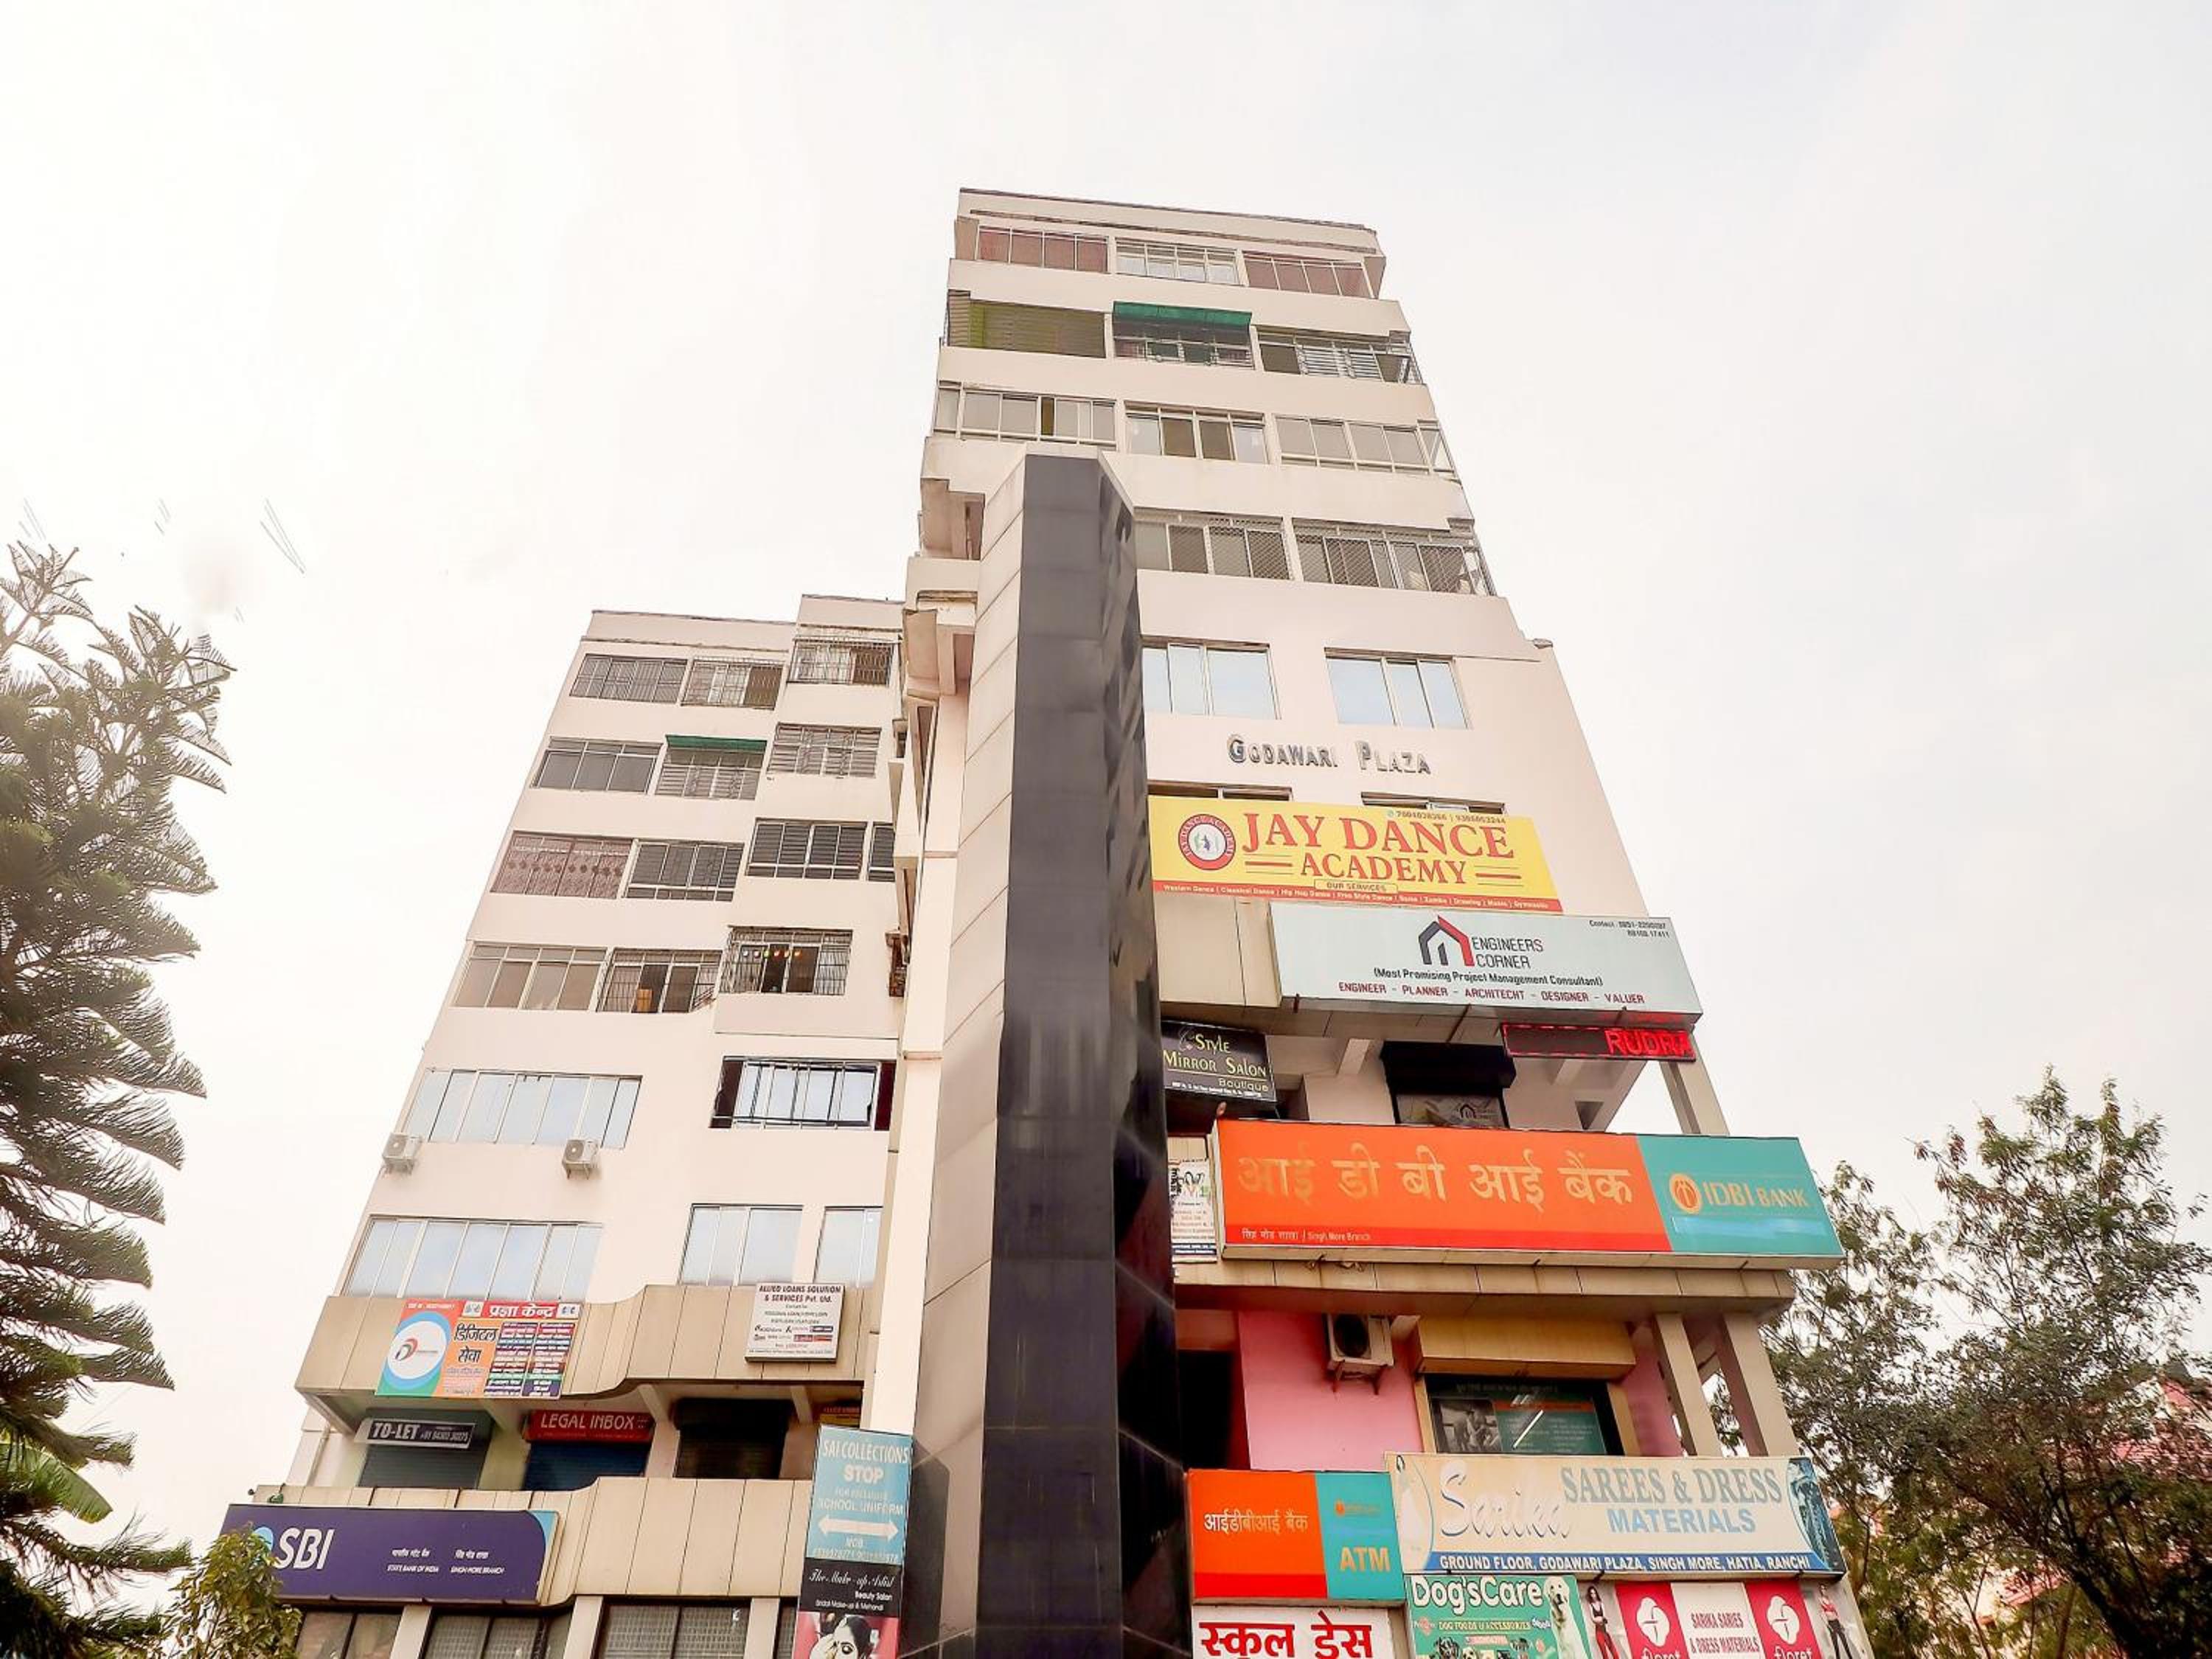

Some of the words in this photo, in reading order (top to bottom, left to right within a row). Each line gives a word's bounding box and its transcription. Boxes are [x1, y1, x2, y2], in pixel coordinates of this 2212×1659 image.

[1356, 741, 1430, 774] PLAZA
[1242, 813, 1325, 853] JAY
[1339, 817, 1514, 858] DANCE
[1301, 852, 1467, 884] ACADEMY
[1326, 882, 1344, 890] OUR
[1346, 883, 1386, 892] SERVICES
[1472, 936, 1544, 953] ENGINEERS
[1476, 953, 1531, 969] CORNER
[1402, 969, 1451, 982] Promising
[1453, 971, 1487, 984] Project
[1489, 973, 1548, 986] Management
[1338, 981, 1386, 994] ENGINEER
[1402, 984, 1448, 997] PLANNER
[1540, 991, 1589, 1003] DESIGNER
[1604, 993, 1645, 1004] VALUER
[1225, 1057, 1266, 1078] Salon
[1218, 1077, 1269, 1092] Boutique
[1239, 1142, 1317, 1209] आई
[1331, 1142, 1380, 1200] डी
[1394, 1144, 1447, 1203] बी
[1469, 1148, 1545, 1214] आई
[1557, 1149, 1632, 1205] बैंक
[1703, 1183, 1755, 1207] IDBI
[1759, 1187, 1808, 1208] BANK
[771, 1294, 804, 1302] SERVICES
[783, 1285, 805, 1293] LOANS
[807, 1285, 841, 1294] SOLUTION
[454, 1323, 499, 1342] डिजिटल
[458, 1346, 483, 1363] सेवा
[372, 1422, 420, 1440] TO-LET
[540, 1413, 586, 1429] LEGAL
[590, 1415, 635, 1430] INBOX
[822, 1439, 838, 1458] SAI
[841, 1441, 908, 1464] COLLECTIONS
[844, 1464, 885, 1484] STOP
[1561, 1467, 1666, 1504] SAREES
[1672, 1470, 1692, 1504] &
[1693, 1468, 1782, 1504] DRESS
[819, 1498, 855, 1511] SCHOOL
[860, 1499, 904, 1515] UNIFORM
[1203, 1508, 1281, 1534] आईडीबीआई
[1286, 1509, 1309, 1533] बैंक
[1606, 1508, 1756, 1534] MATERIALS
[274, 1528, 335, 1570] SBI
[1340, 1546, 1391, 1573] ATM
[1440, 1555, 1491, 1570] GROUND
[1494, 1556, 1536, 1571] FLOOR,
[1539, 1557, 1601, 1571] GODAWARI
[1605, 1557, 1647, 1571] PLAZA,
[1649, 1557, 1685, 1570] SINGH
[1689, 1557, 1725, 1571] MORE,
[1728, 1557, 1765, 1571] HATIA,
[1767, 1556, 1810, 1570] RANCHI
[855, 1590, 874, 1601] Beauty
[876, 1591, 893, 1601] Salon
[1691, 1613, 1719, 1628] SARIKA
[1198, 1622, 1295, 1659] स्कल
[1696, 1638, 1720, 1653] DRESS
[1719, 1637, 1760, 1652] MATERIALS
